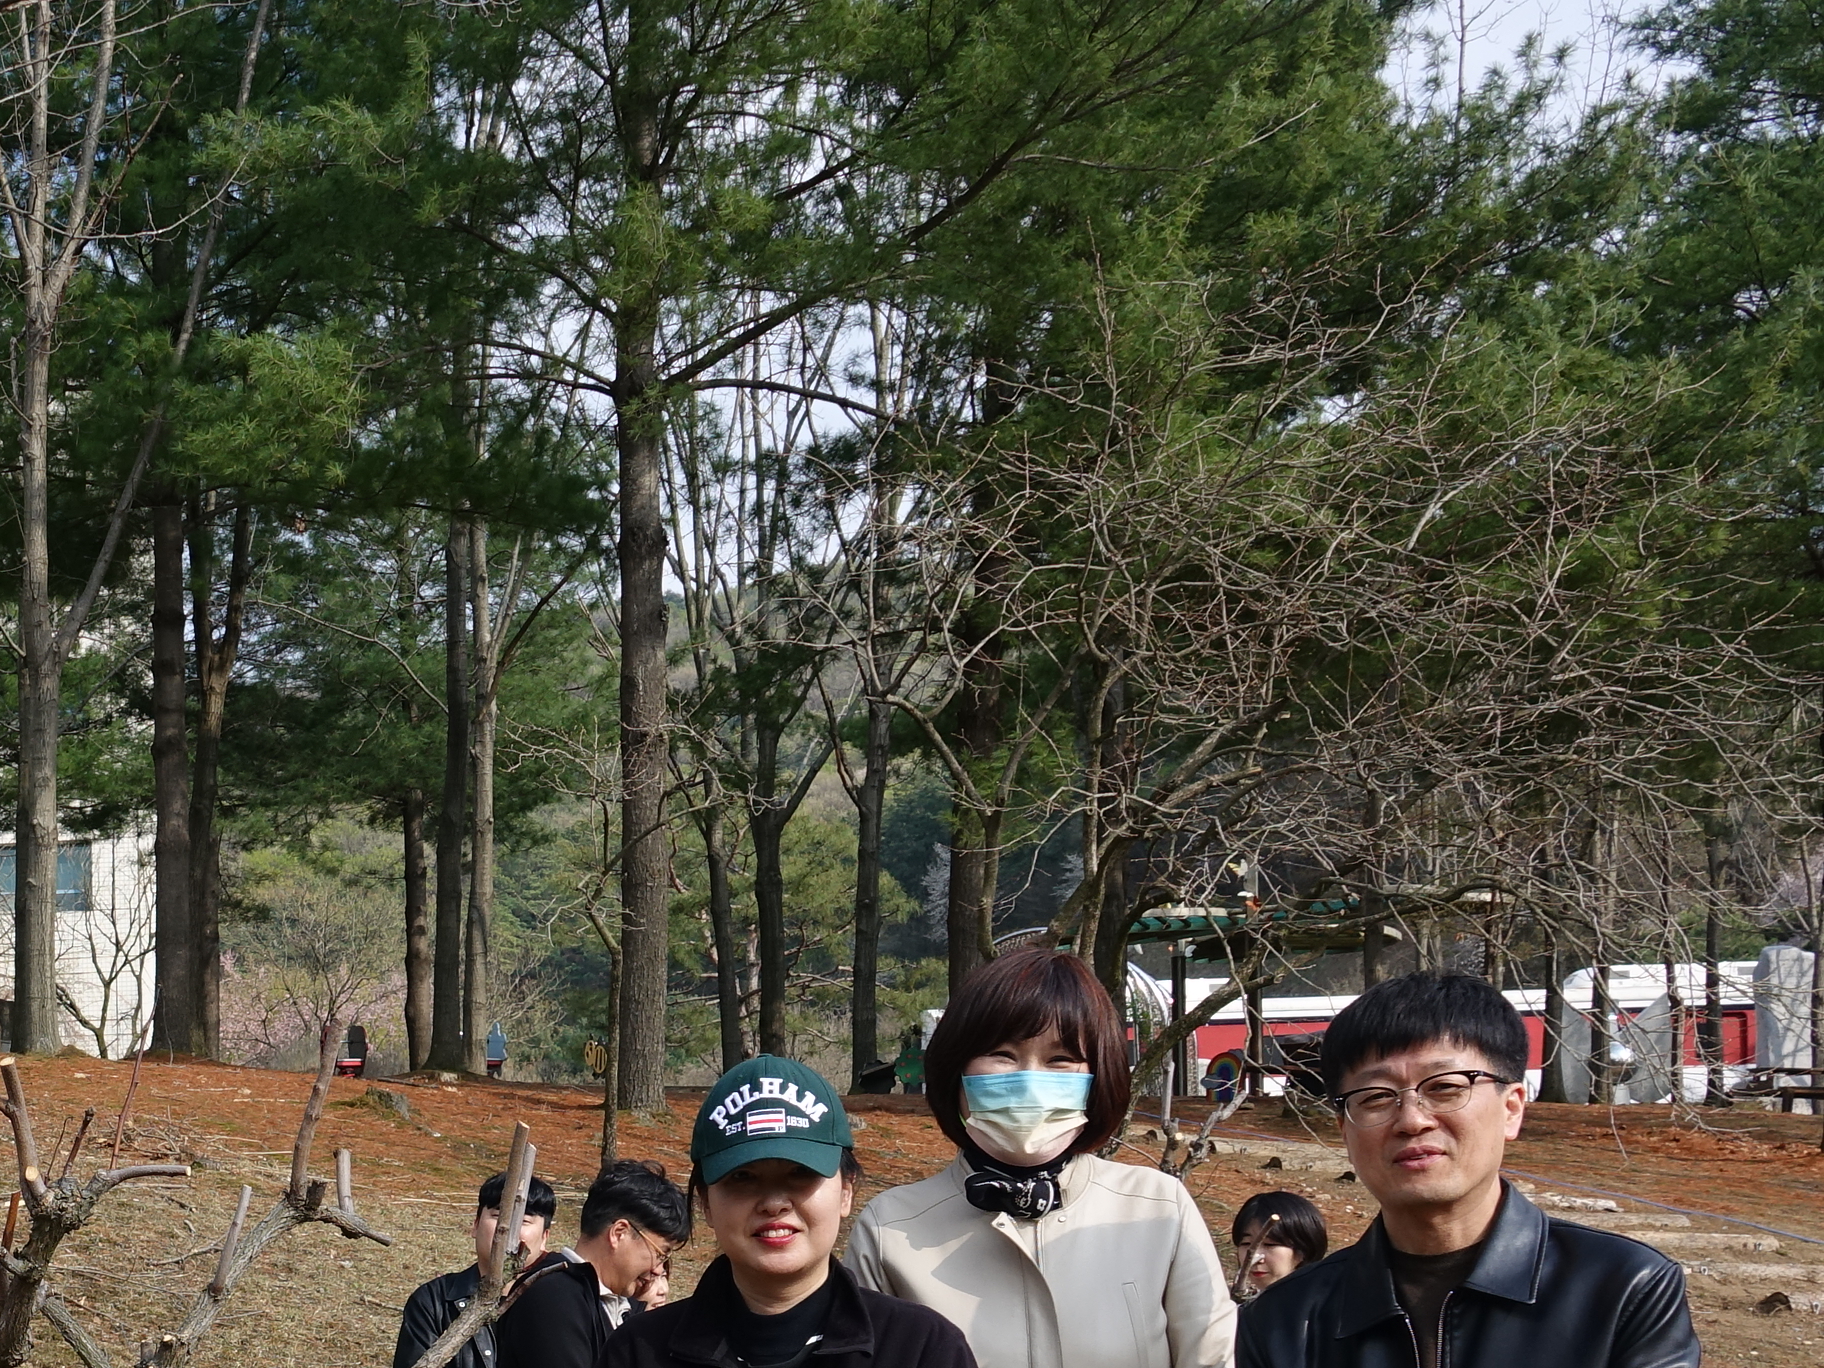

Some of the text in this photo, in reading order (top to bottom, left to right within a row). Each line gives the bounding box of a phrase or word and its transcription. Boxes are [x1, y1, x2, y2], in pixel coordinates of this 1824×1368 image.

[709, 1077, 829, 1130] POLHAM
[725, 1115, 810, 1136] EST. 1830
